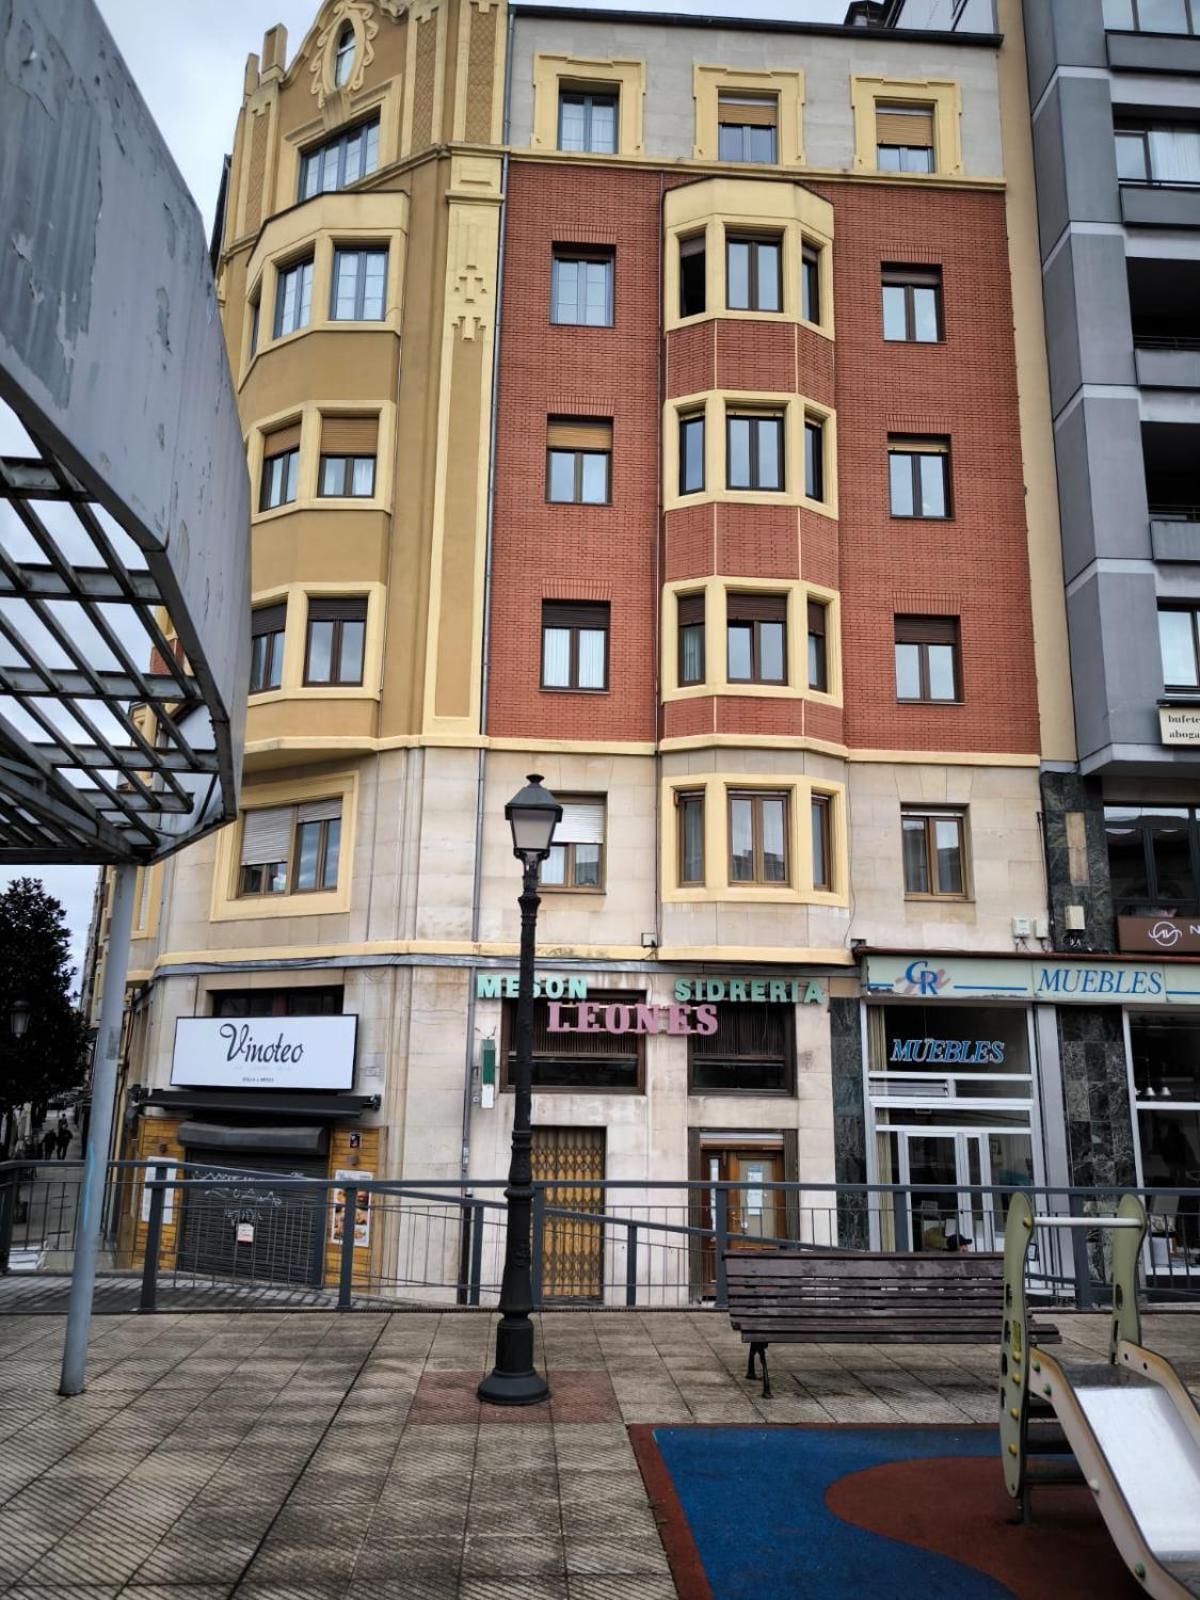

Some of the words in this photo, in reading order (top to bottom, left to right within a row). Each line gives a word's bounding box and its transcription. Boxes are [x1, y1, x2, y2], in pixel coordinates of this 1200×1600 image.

[674, 978, 826, 1004] SIDRERIA
[904, 960, 938, 995] CR
[1037, 967, 1162, 995] MUEBLES
[546, 1001, 719, 1036] LEONES
[219, 1022, 304, 1064] Vinoteo
[889, 1037, 1005, 1064] MUEBLES
